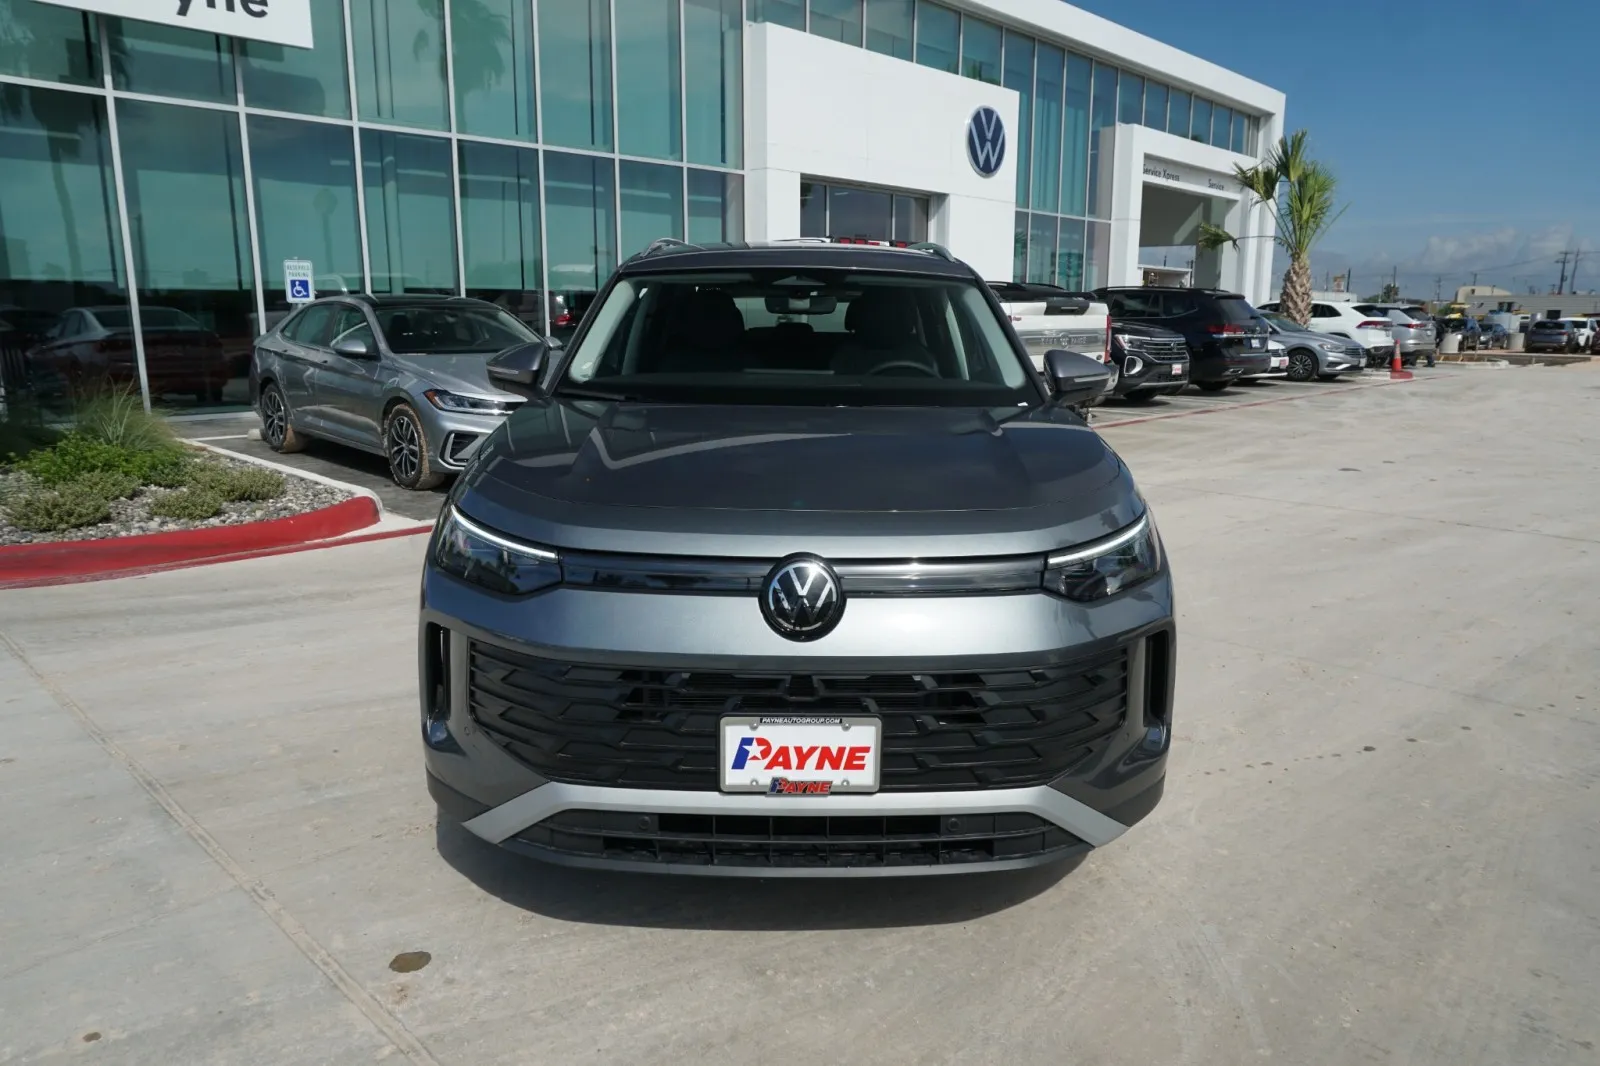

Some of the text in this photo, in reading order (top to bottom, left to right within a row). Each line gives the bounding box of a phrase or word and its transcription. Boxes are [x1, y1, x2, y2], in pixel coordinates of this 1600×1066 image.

[968, 106, 1005, 172] VW
[1163, 168, 1180, 181] Xpress
[1208, 178, 1225, 191] Service
[770, 563, 836, 628] VW
[731, 737, 871, 770] PAYNE
[769, 777, 832, 793] PAYNE
